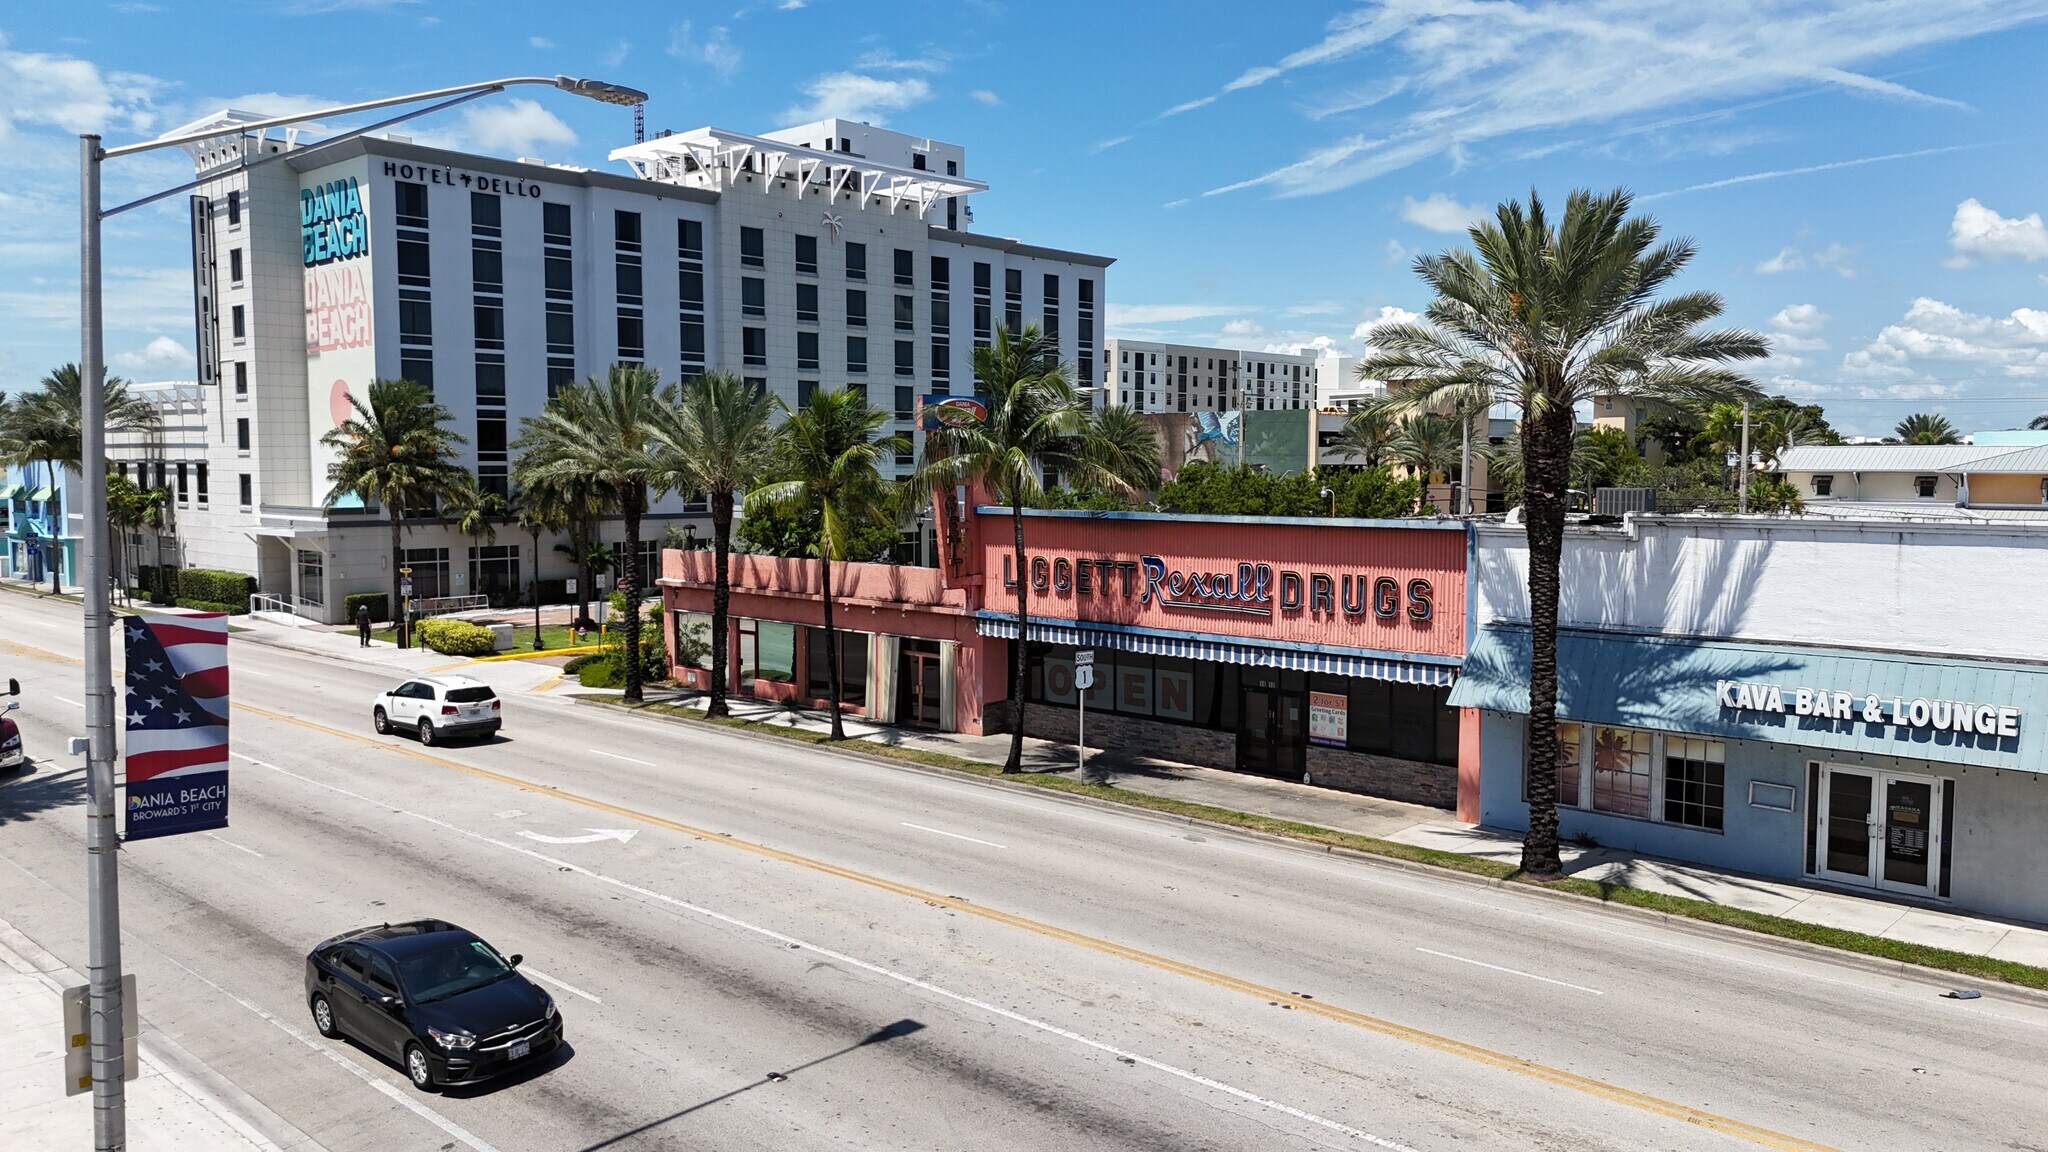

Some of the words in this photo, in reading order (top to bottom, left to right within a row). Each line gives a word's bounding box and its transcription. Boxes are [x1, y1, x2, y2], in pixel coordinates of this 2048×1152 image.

[302, 176, 363, 227] DANIA
[384, 161, 456, 187] HOTEL
[477, 175, 542, 199] DELLO
[304, 212, 369, 267] BEACH
[305, 266, 367, 312] DANIA
[306, 304, 372, 352] BEACH
[1003, 554, 1137, 598] LGGETT
[1140, 555, 1273, 605] Rexall
[1280, 570, 1434, 622] DRUGS
[1076, 653, 1093, 662] SOUTH
[1313, 696, 1319, 705] 2
[1320, 698, 1333, 706] for
[1716, 679, 1785, 713] KAVA
[1795, 686, 1853, 720] BAR
[1862, 693, 1885, 723] &
[1892, 695, 2021, 737] LOUNGE
[128, 793, 173, 809] DANIA
[182, 785, 226, 802] BEACH
[134, 806, 187, 820] BROWARD'S
[203, 801, 221, 811] CITY
